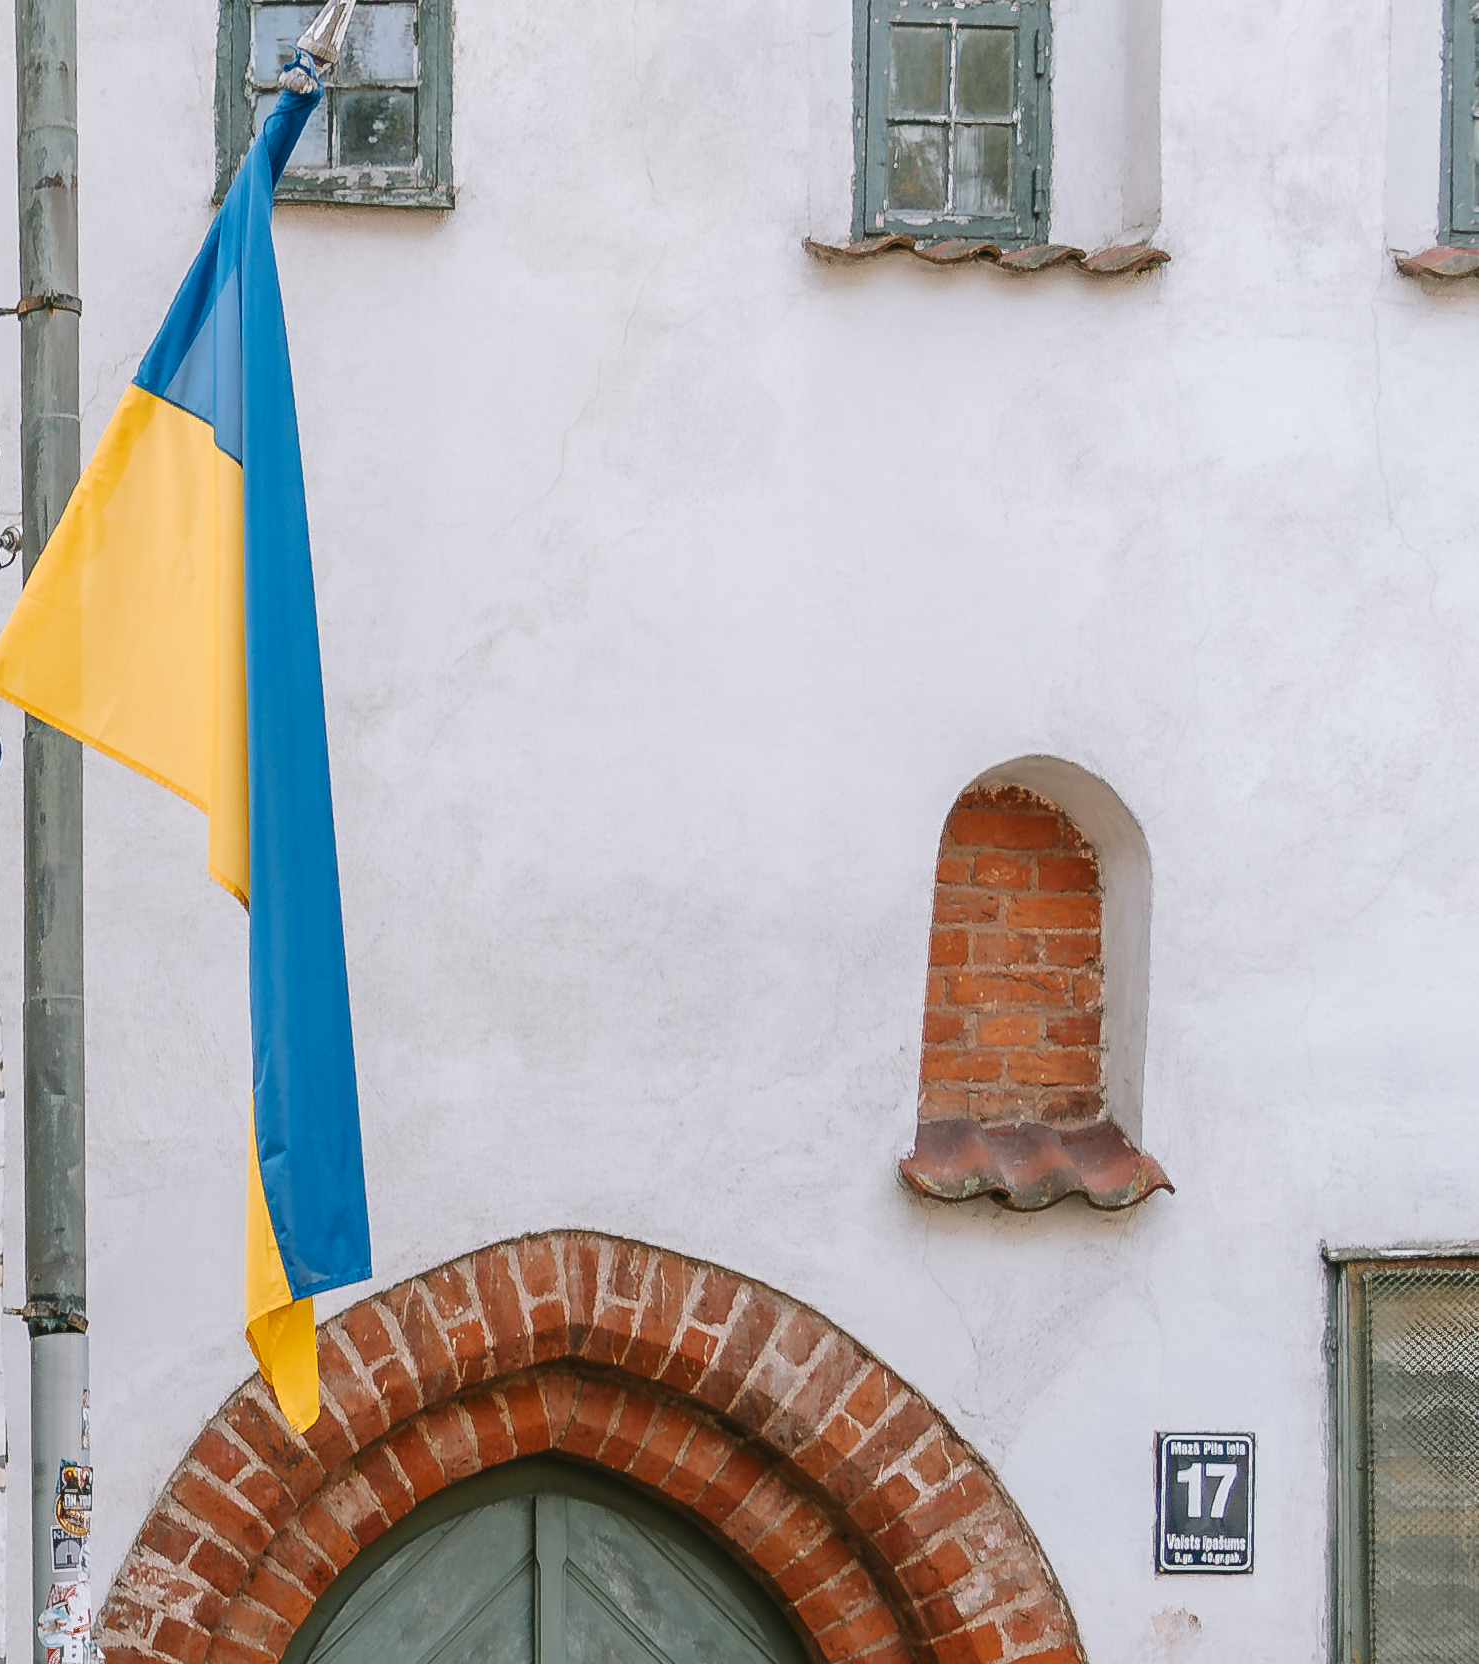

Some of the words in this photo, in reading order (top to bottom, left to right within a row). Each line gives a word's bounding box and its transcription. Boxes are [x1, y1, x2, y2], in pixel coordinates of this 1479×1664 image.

[1204, 1441, 1224, 1456] Pils
[1176, 1462, 1238, 1519] 17
[1166, 1533, 1201, 1551] Valsts
